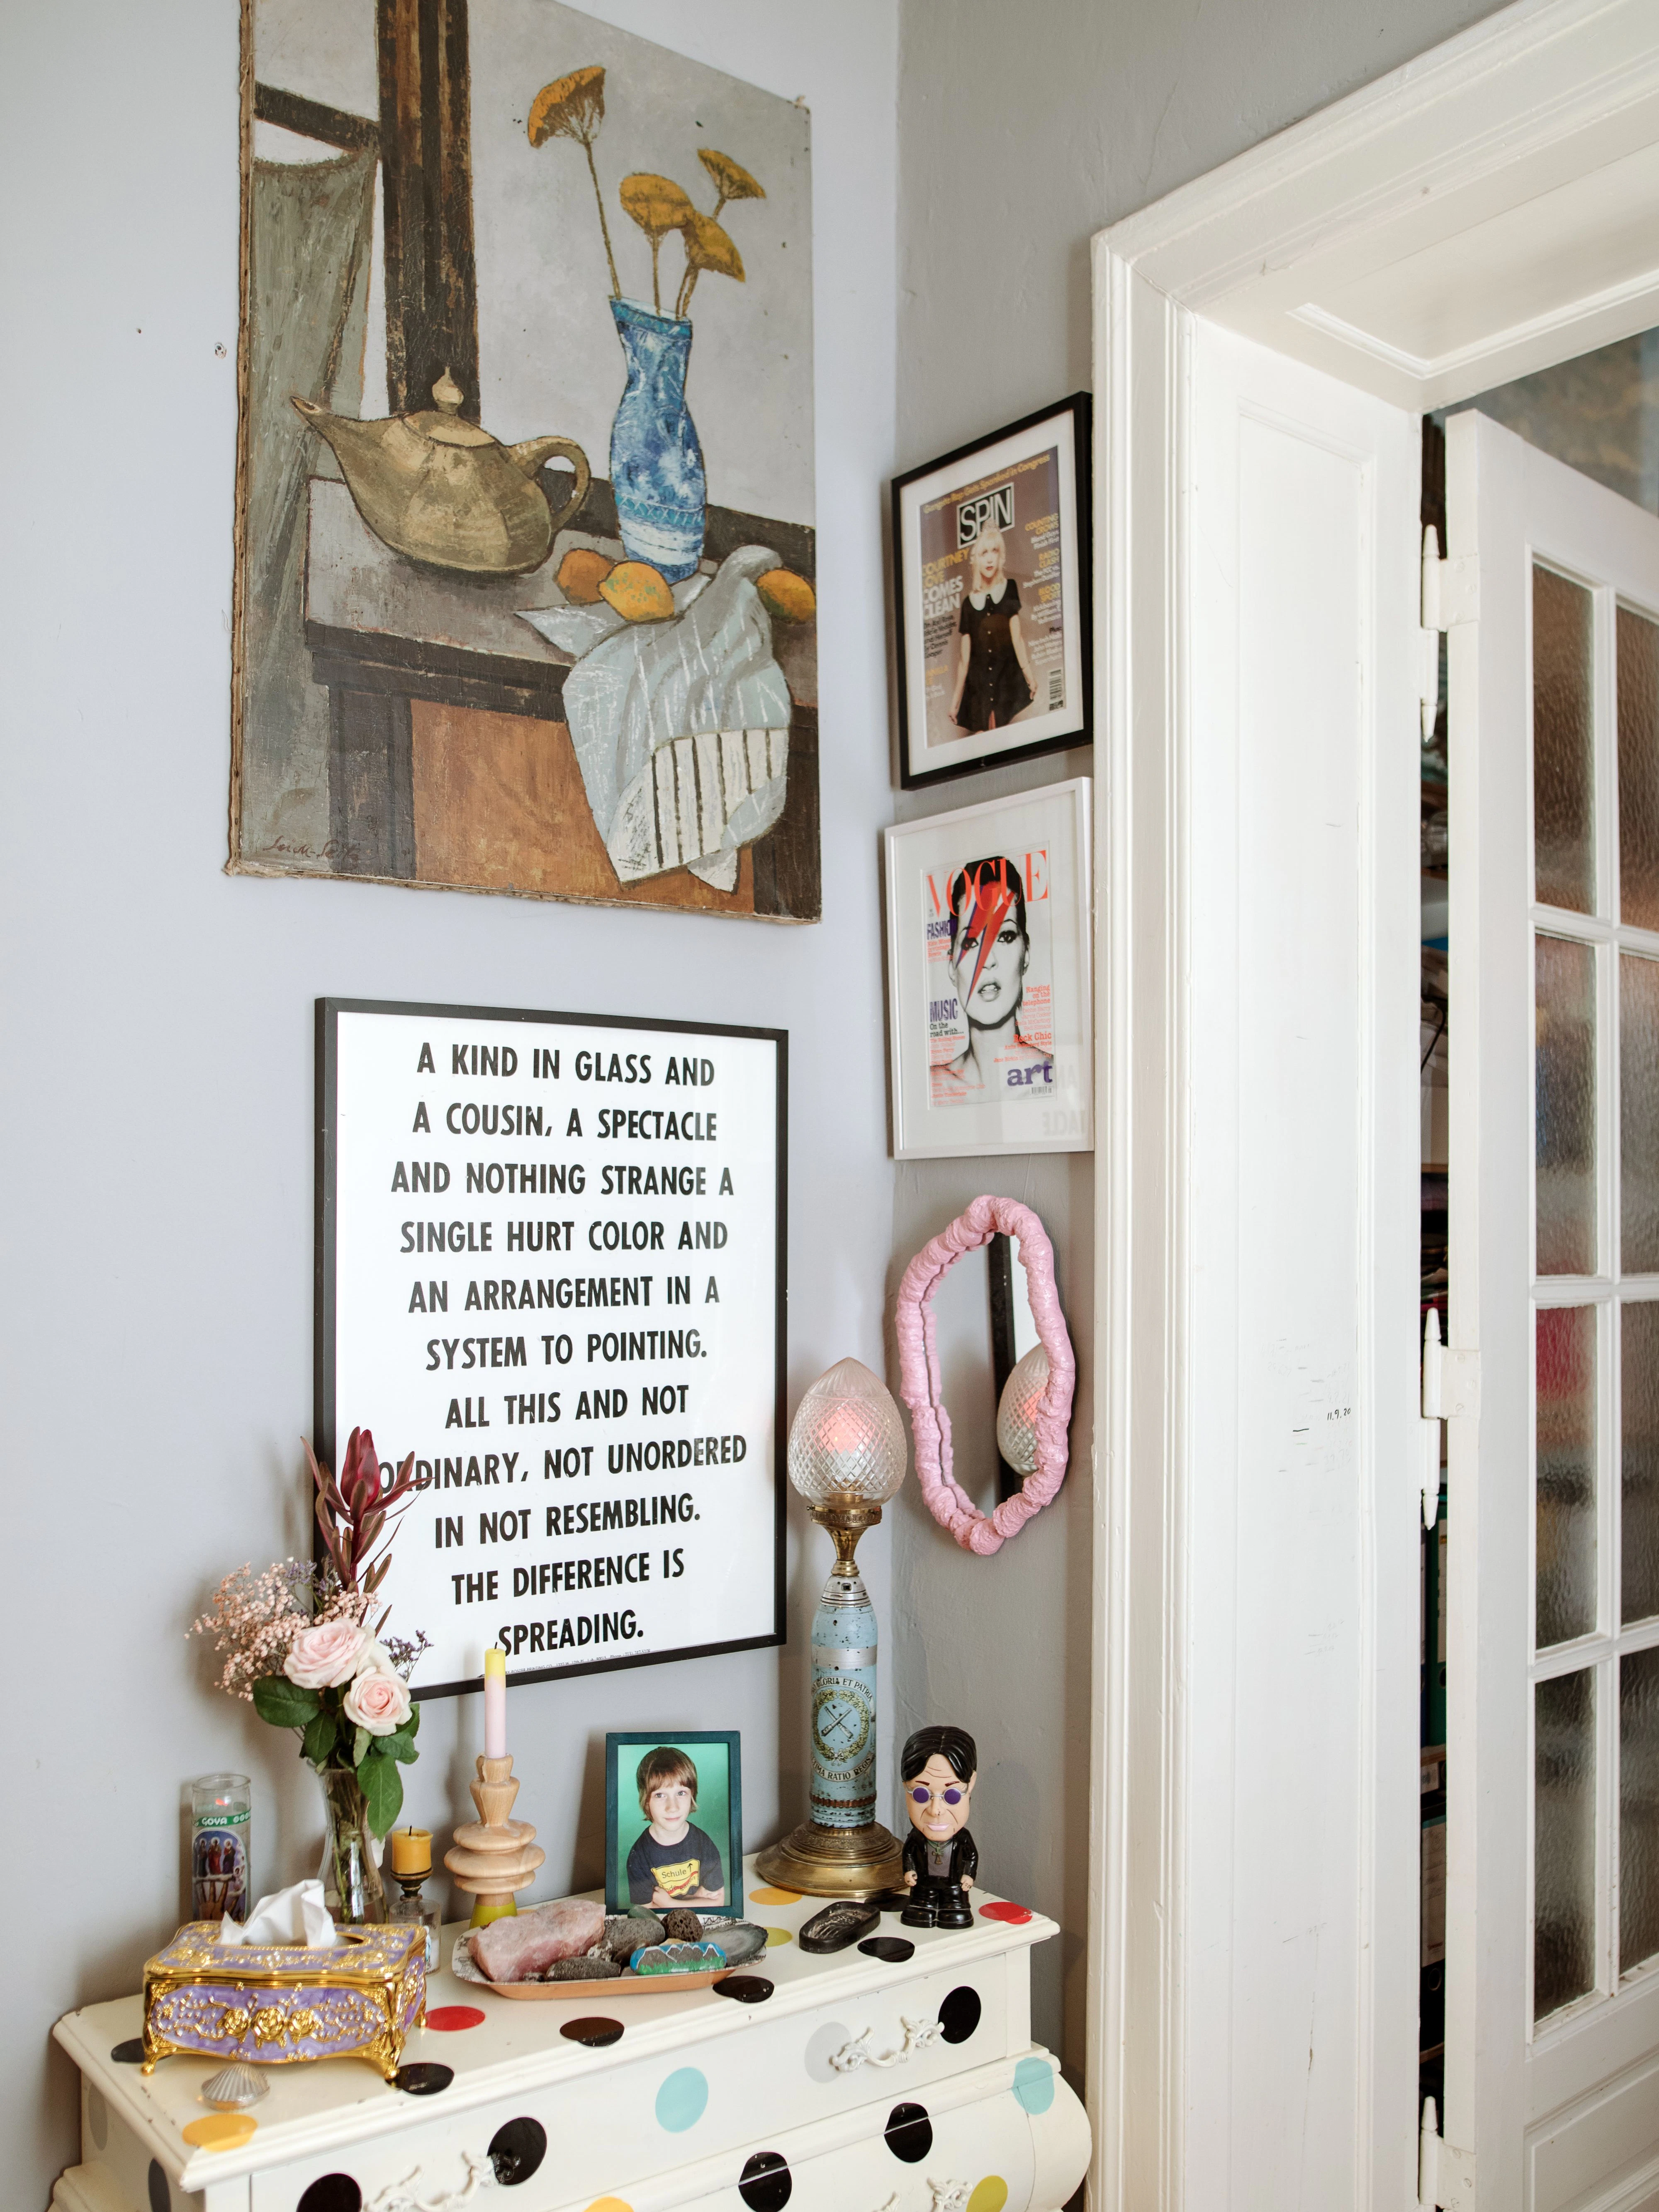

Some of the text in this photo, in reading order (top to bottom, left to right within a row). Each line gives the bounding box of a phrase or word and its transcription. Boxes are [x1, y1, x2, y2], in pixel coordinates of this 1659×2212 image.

[961, 488, 1012, 541] SPIN
[923, 575, 963, 604] COMES
[923, 593, 960, 620] CLEAN
[926, 850, 1048, 917] VOGUE
[927, 918, 958, 940] FASHIO
[1026, 985, 1050, 993] Hanging
[930, 998, 958, 1022] MUSIC
[1013, 1030, 1052, 1042] Rock Chic
[417, 1043, 714, 1085] A KIND IN GLASS AND
[1007, 1061, 1053, 1086] art
[413, 1102, 716, 1140] A COUSIN, A SPECTACLE
[392, 1162, 733, 1195] AND NOTHING STRANGE A
[400, 1221, 727, 1253] SINGLE HURT COLOR AND
[409, 1276, 719, 1313] AN ARRANGEMENT IN A
[426, 1329, 706, 1370] SYSTEM TO POINTING.
[445, 1385, 688, 1428] ALL THIS AND NOT
[1327, 1408, 1350, 1420] 11.9.20
[545, 1446, 593, 1479] NOT
[608, 1435, 746, 1474] UNORDERED
[436, 1493, 700, 1548] IN NOT RESEMBLING.
[452, 1548, 684, 1605] THE DIFFERENCE IS
[499, 1610, 644, 1657] SPREADING.
[854, 1756, 871, 1776] REGIS
[202, 1817, 227, 1826] GOYA
[662, 1869, 686, 1878] Schule
